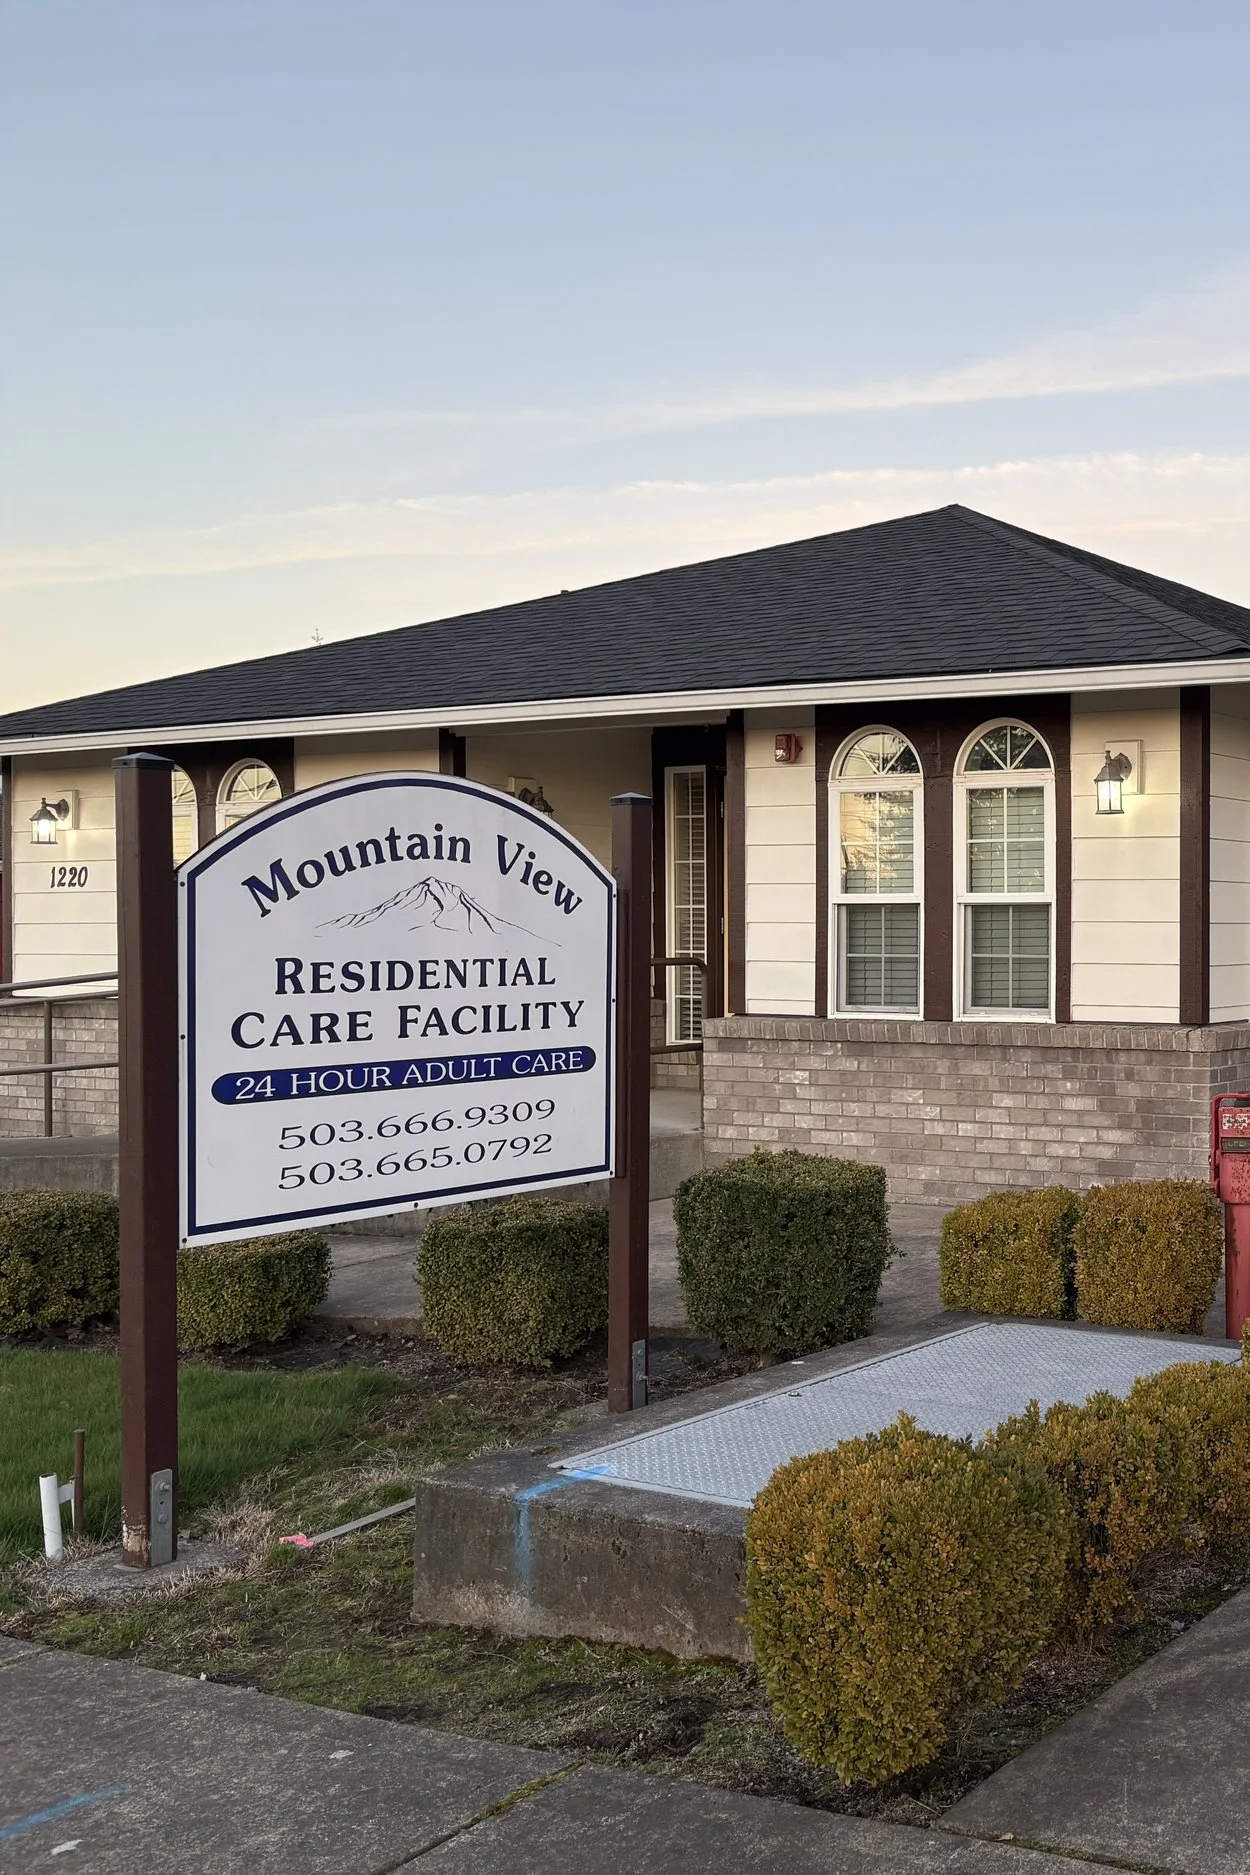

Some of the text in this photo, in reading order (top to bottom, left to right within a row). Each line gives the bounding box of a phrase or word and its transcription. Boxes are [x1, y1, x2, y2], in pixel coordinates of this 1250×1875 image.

[50, 866, 88, 888] 1220
[242, 823, 583, 917] Mountain View
[274, 956, 556, 996] RESIDENTIAL
[230, 1000, 585, 1049] CARE FACILITY
[235, 1050, 584, 1100] 24 HOUR ADULT CARE
[277, 1098, 556, 1151] 503.666.9309
[277, 1133, 553, 1191] 503.665.0792
